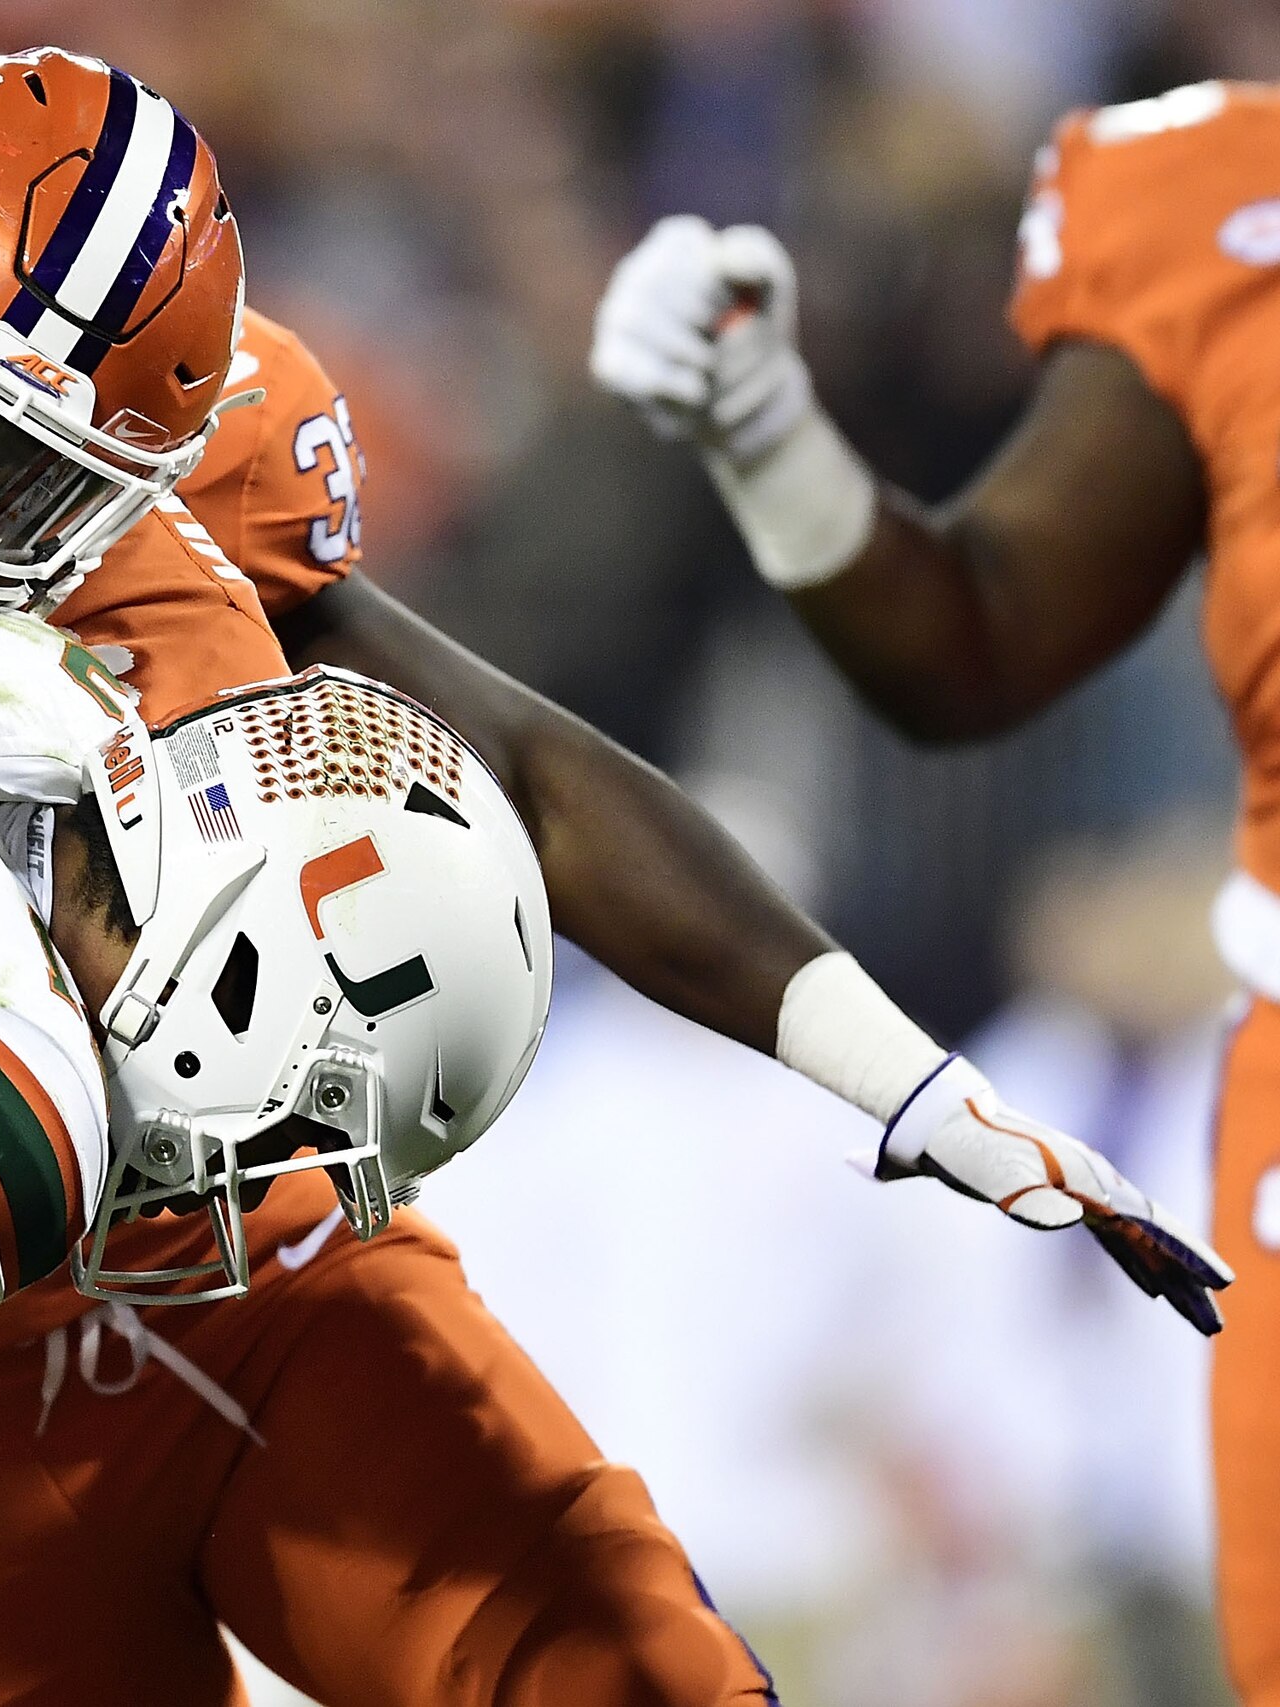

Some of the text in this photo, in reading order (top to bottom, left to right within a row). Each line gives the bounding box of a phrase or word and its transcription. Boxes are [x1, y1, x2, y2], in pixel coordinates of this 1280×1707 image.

[5, 353, 80, 398] ACC
[212, 716, 235, 737] 12
[299, 834, 435, 1018] U
